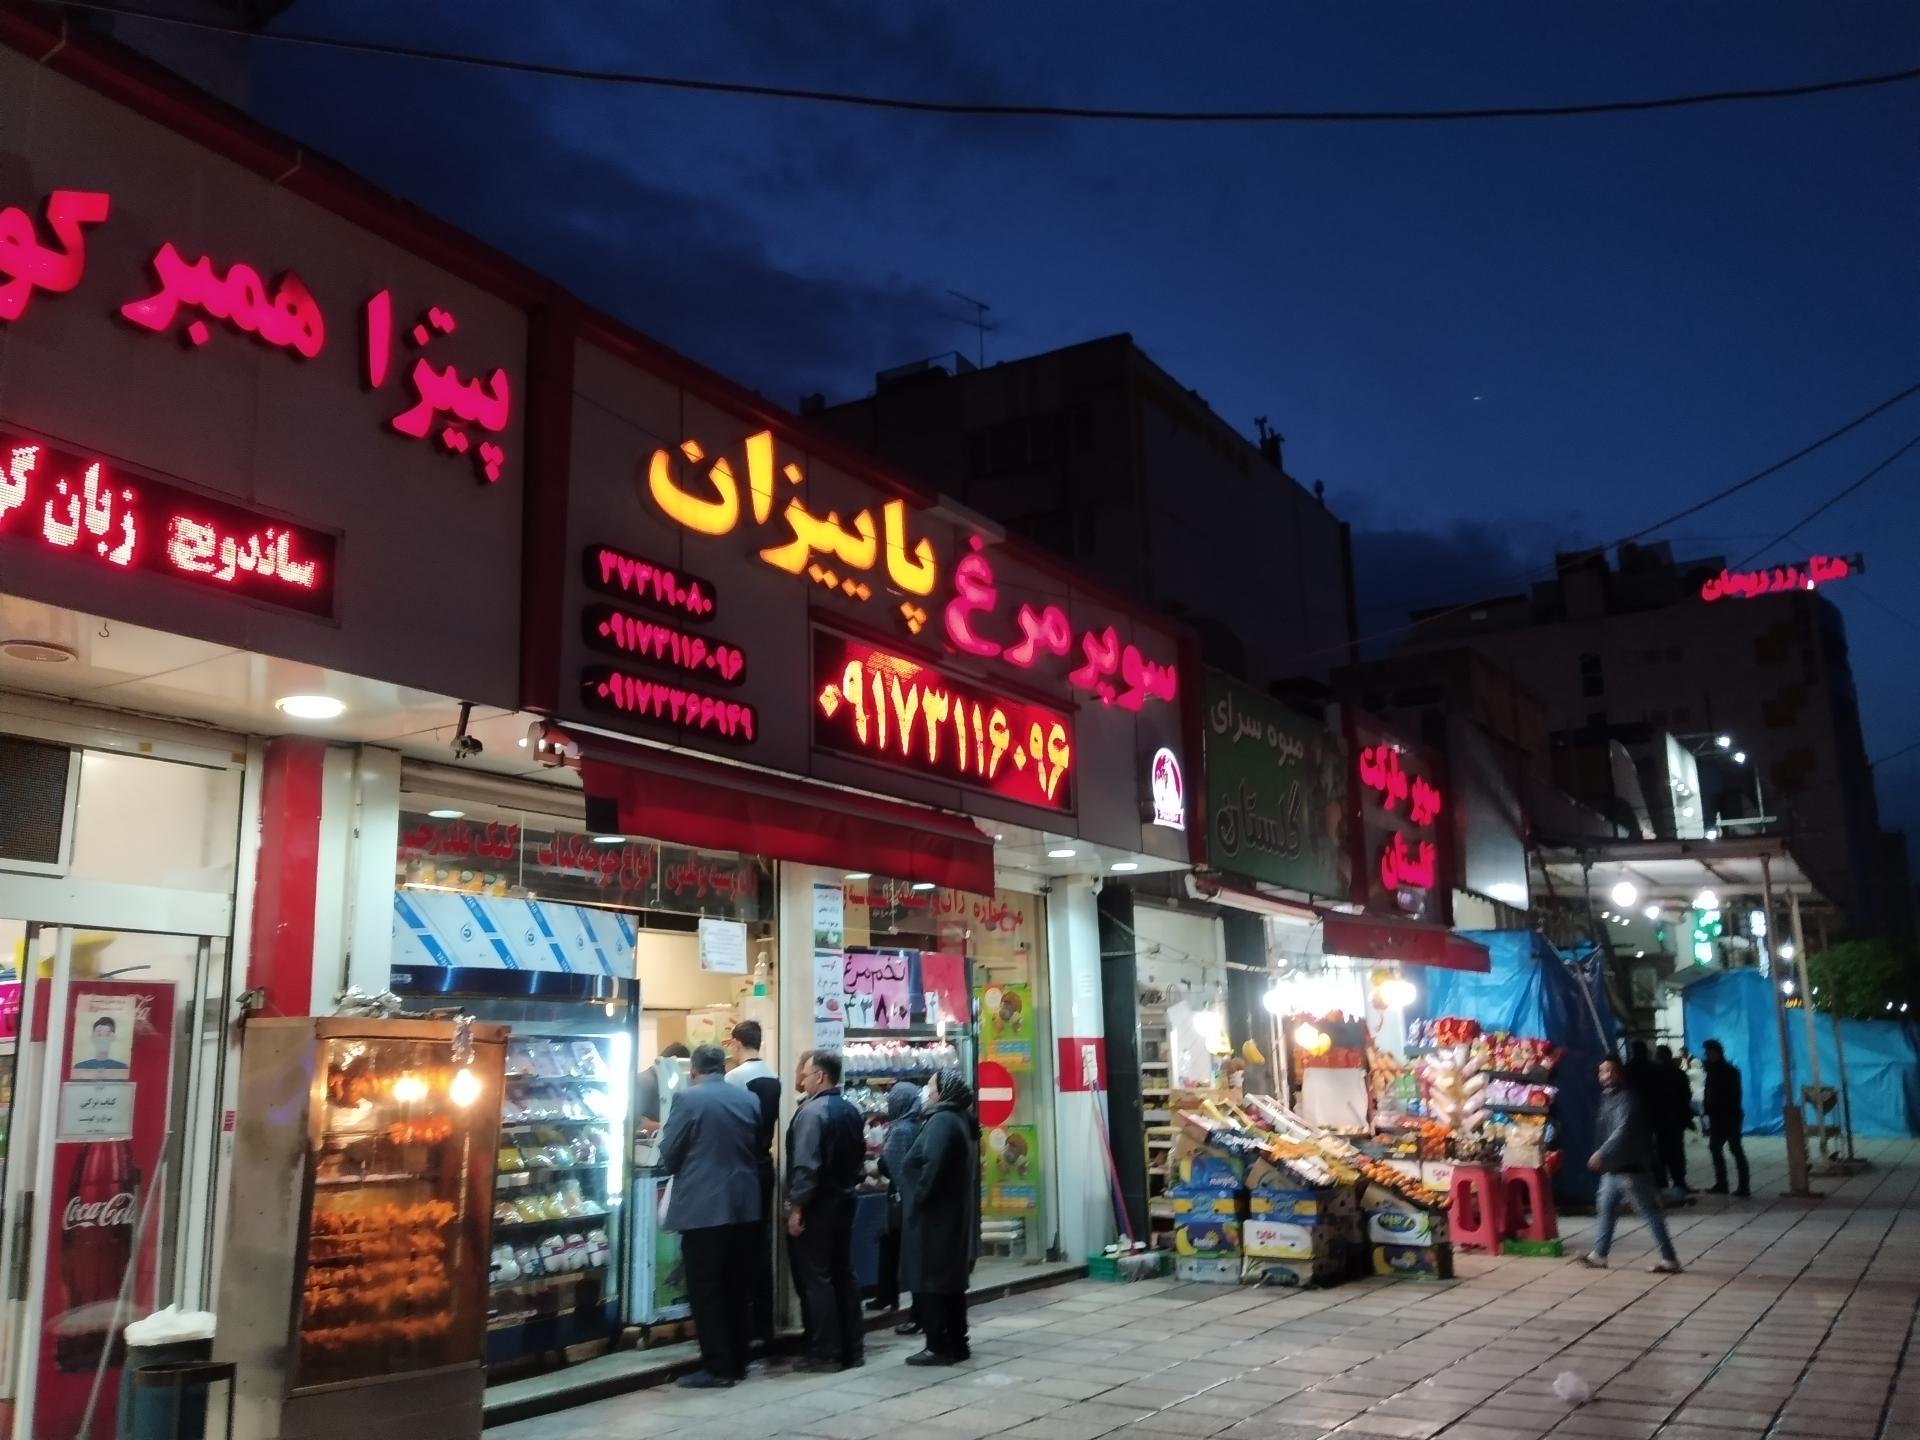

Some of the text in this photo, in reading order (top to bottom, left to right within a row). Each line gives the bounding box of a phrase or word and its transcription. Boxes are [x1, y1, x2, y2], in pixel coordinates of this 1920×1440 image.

[121, 242, 325, 358] همبر
[368, 289, 510, 482] پیتزا
[43, 462, 137, 566] زبان
[648, 430, 1178, 711] سوپر مرغ پاییزان
[599, 612, 743, 680] ۰۹۱۷۳۱۱۶۰۹۶
[819, 659, 1070, 800] ۰۹۱۷۳۱۱۶۰۹۶
[1210, 692, 1304, 768] میوه سرای
[537, 831, 580, 877] کباب
[1215, 777, 1303, 861] گلستان
[578, 846, 620, 888] جوجه
[844, 954, 906, 995] تخم مرغ
